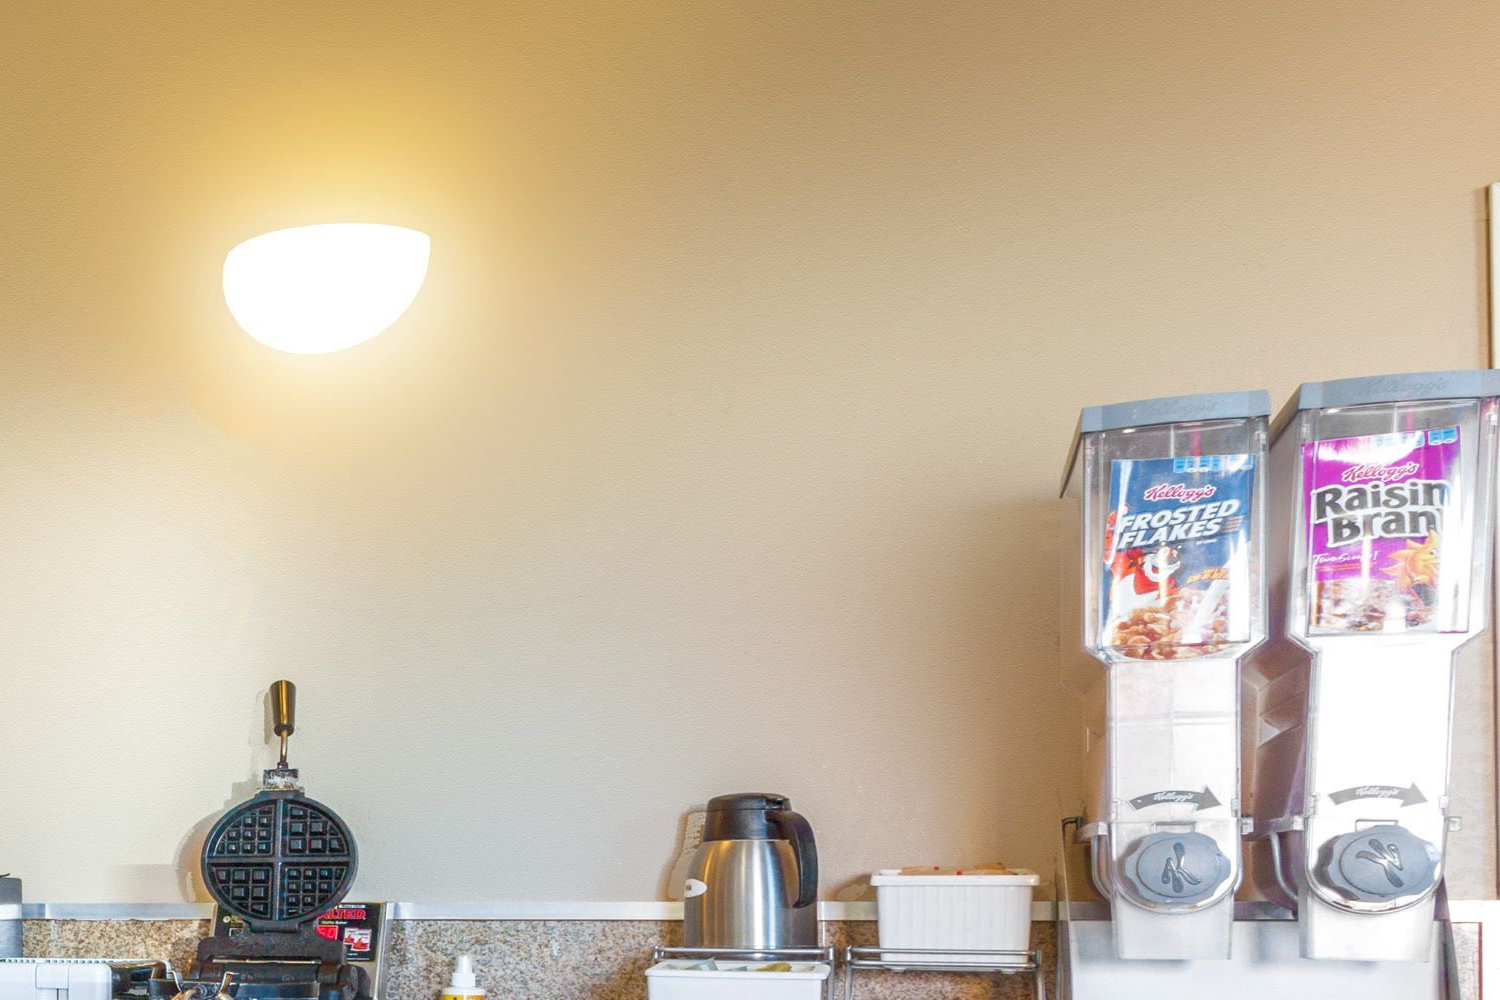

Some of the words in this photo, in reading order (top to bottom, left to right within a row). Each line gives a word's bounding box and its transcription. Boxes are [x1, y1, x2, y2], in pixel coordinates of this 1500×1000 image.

[1342, 461, 1420, 482] Kellogg's
[1143, 483, 1217, 502] Kellogg's
[1311, 480, 1449, 522] Raisin
[1120, 500, 1240, 532] FROSTED
[1328, 509, 1440, 546] Bran
[1116, 518, 1222, 550] FLAKES
[1153, 791, 1194, 802] Kellogg's
